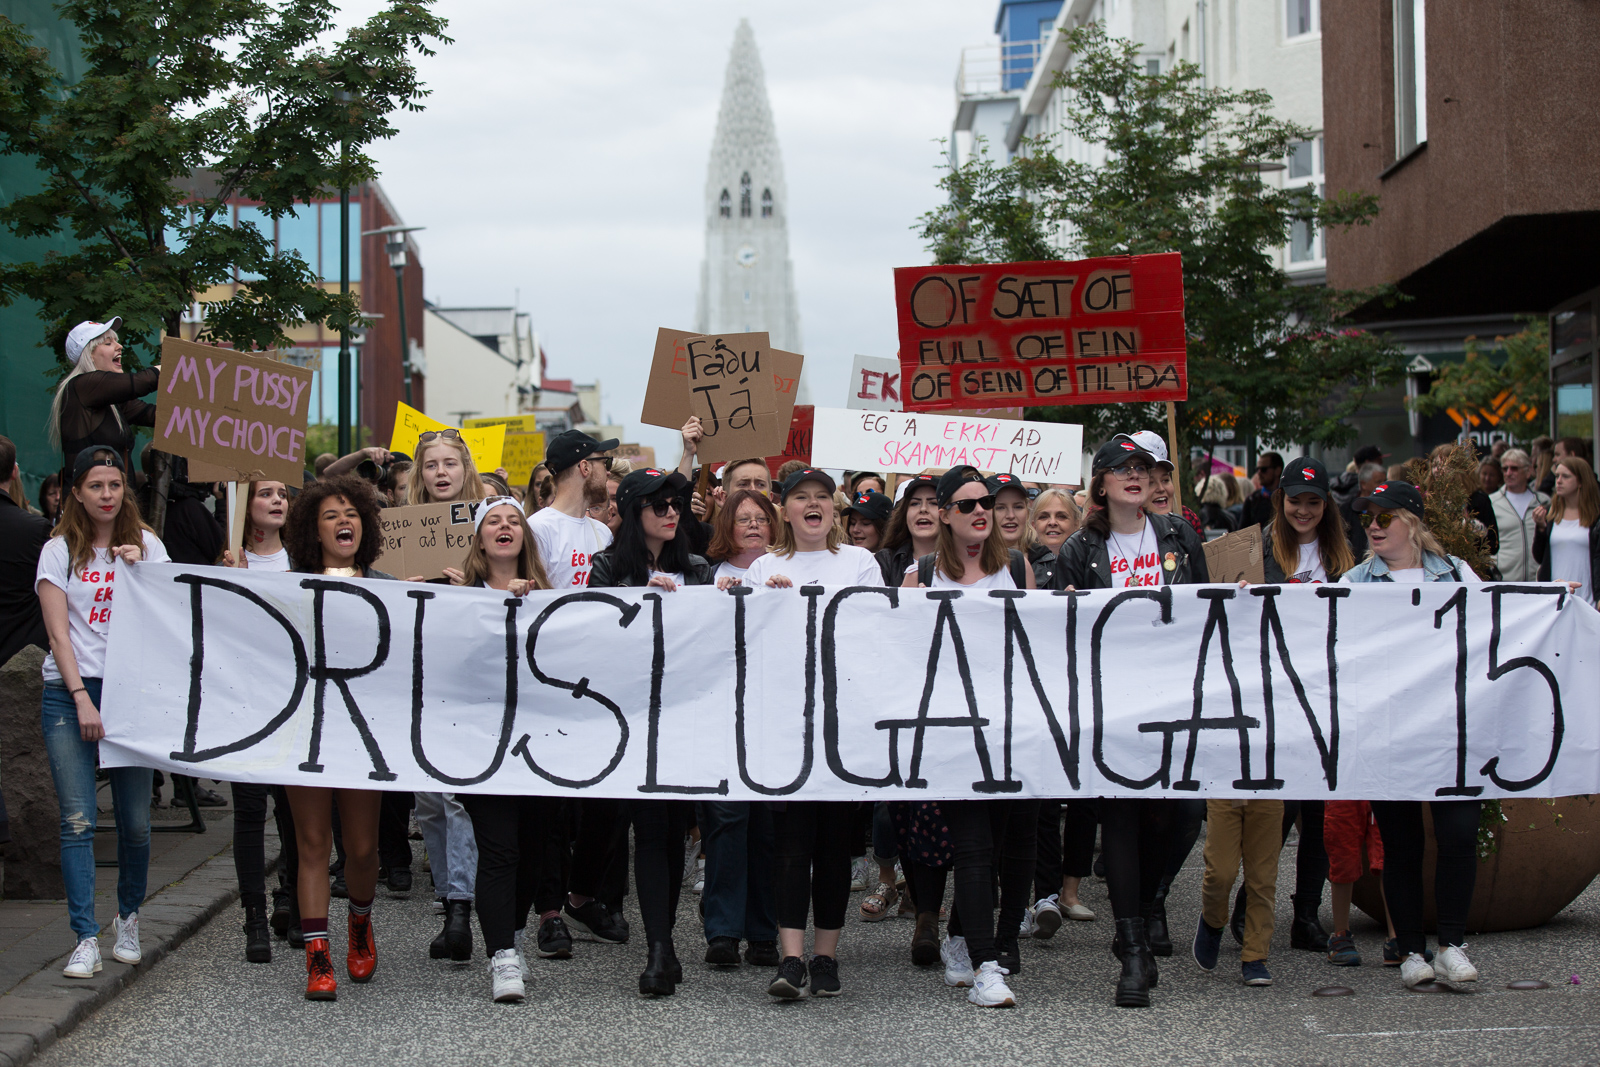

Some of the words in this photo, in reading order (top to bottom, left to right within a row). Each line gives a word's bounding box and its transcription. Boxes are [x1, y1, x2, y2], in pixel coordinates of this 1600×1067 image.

[910, 275, 981, 329] OF
[993, 277, 1075, 320] SÆT
[1085, 274, 1134, 311] OF
[919, 340, 1000, 366] FULL
[1016, 335, 1065, 360] OF
[1078, 331, 1139, 358] EIN
[167, 355, 228, 404] MY
[233, 365, 308, 417] PUSSY
[911, 372, 951, 401] OF
[963, 370, 1023, 395] SEIN
[1034, 367, 1069, 393] OF
[692, 376, 756, 437] Já
[164, 405, 212, 449] MY
[212, 415, 305, 463] CHOICE
[1010, 428, 1042, 448] AÐ
[879, 440, 1008, 470] SKAMMAST
[1009, 451, 1063, 477] MÍN!
[382, 519, 412, 531] etta
[421, 516, 442, 527] var
[82, 566, 100, 583] ÉG
[571, 549, 585, 567] ÉG
[1110, 556, 1129, 573] ÉG
[169, 573, 1351, 796] DRUSLUGANGAN
[1411, 584, 1565, 797] '15
